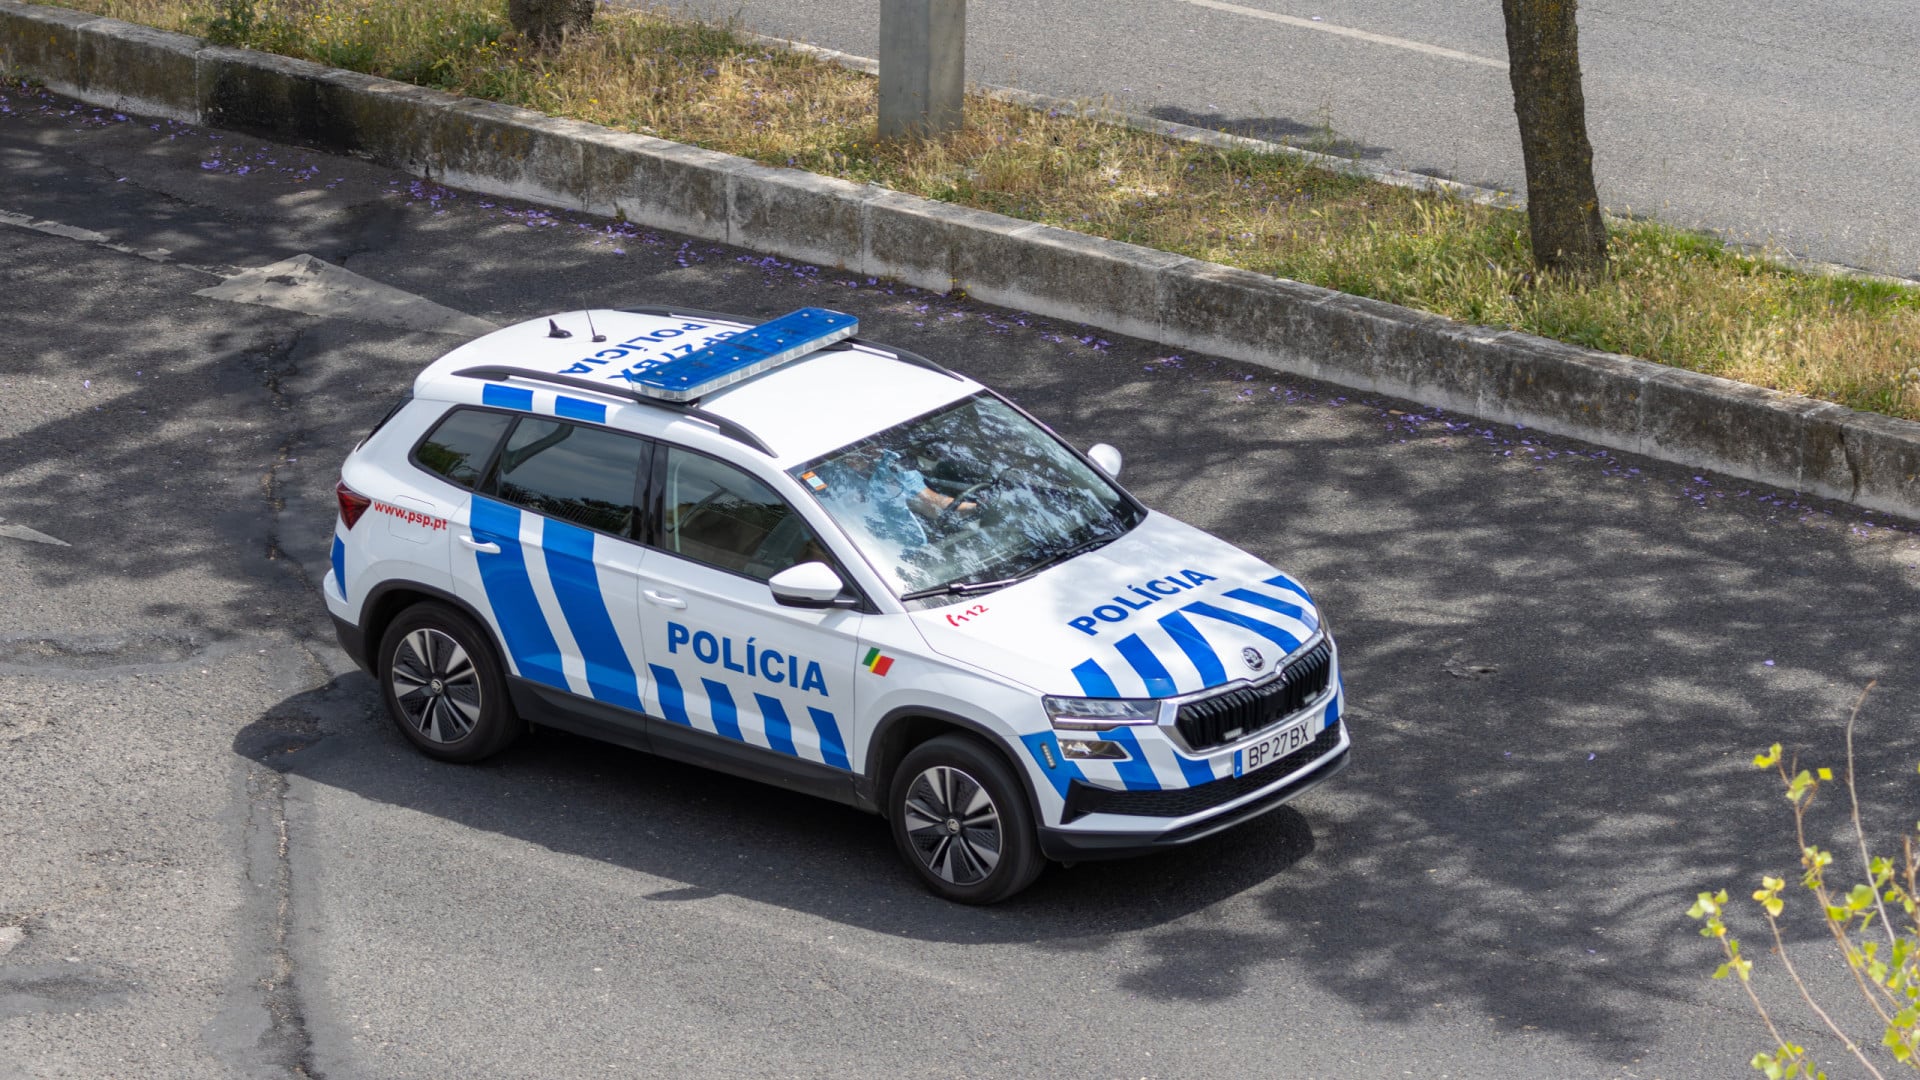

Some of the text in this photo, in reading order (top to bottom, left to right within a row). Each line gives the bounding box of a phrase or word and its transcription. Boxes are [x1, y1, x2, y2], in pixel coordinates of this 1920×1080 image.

[558, 323, 708, 374] POLÍCIA
[374, 501, 448, 531] www.psp.pt
[957, 604, 989, 621] 112
[1067, 568, 1218, 636] POLÍCIA
[667, 621, 829, 697] POLÍCIA
[1249, 721, 1309, 768] BP 27 BX
